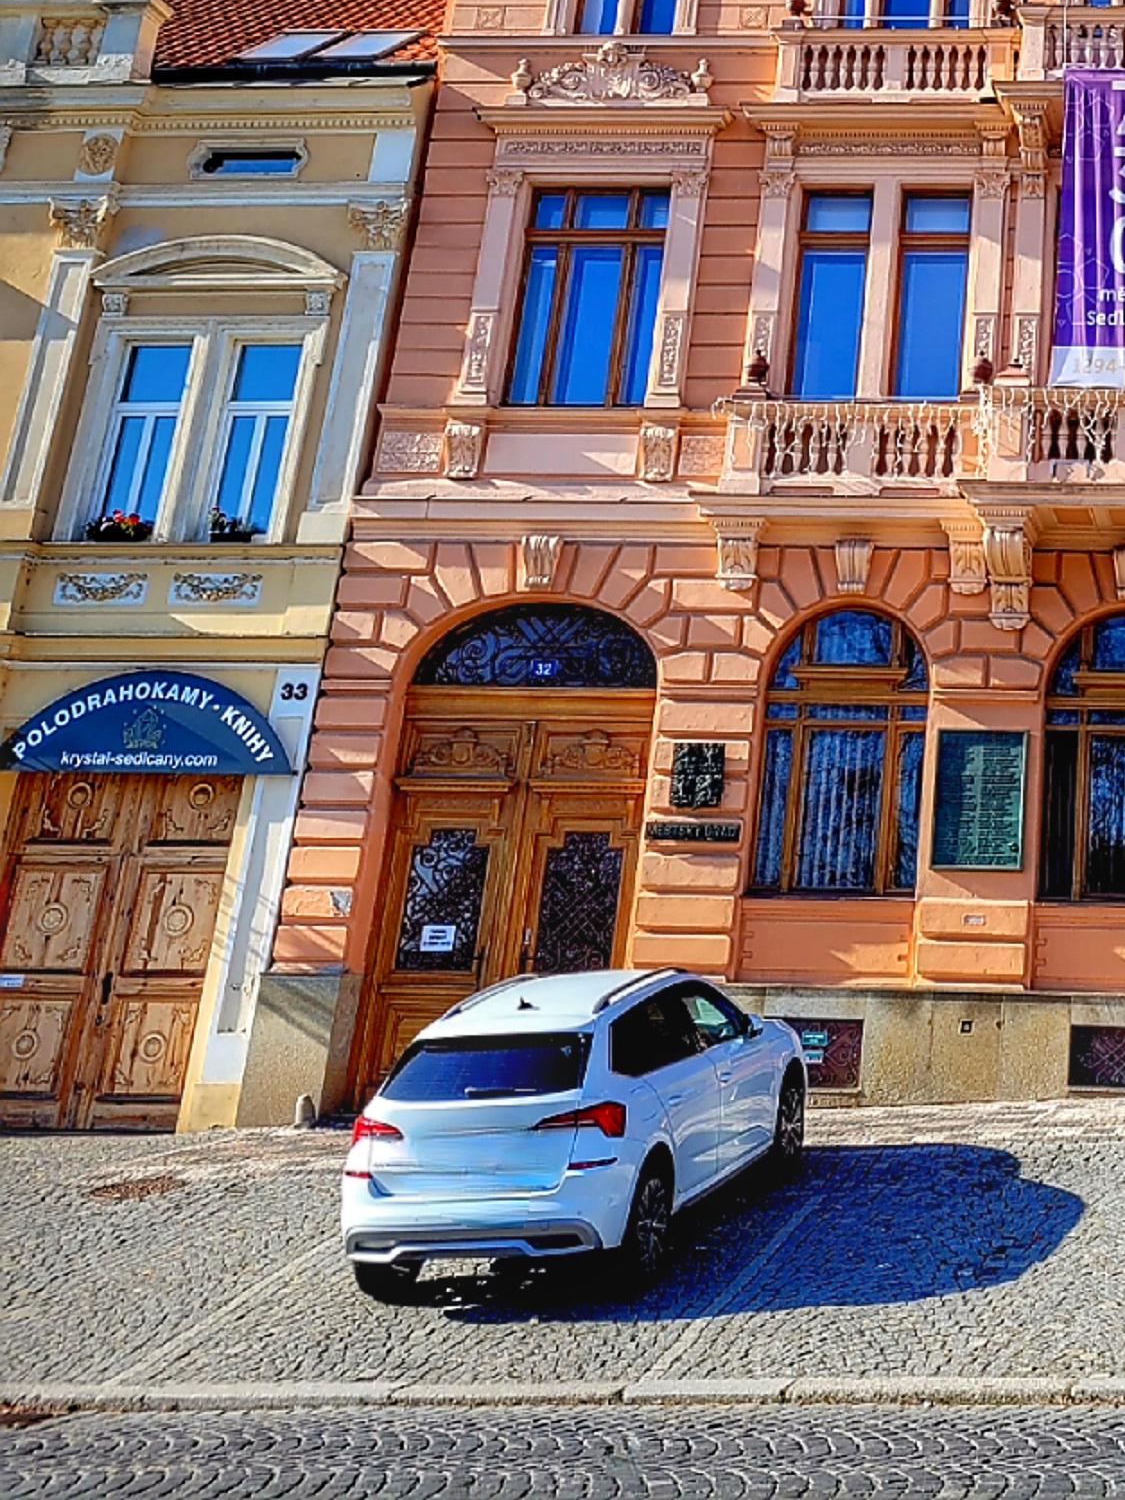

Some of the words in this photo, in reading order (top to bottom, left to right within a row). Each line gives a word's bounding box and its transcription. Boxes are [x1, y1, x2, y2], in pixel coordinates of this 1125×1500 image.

[535, 663, 552, 676] 32
[280, 683, 309, 701] 33
[12, 682, 216, 761] POLODRAHOKAMY
[220, 705, 274, 763] KNIHY
[60, 750, 218, 769] krystal-sedlcany.com
